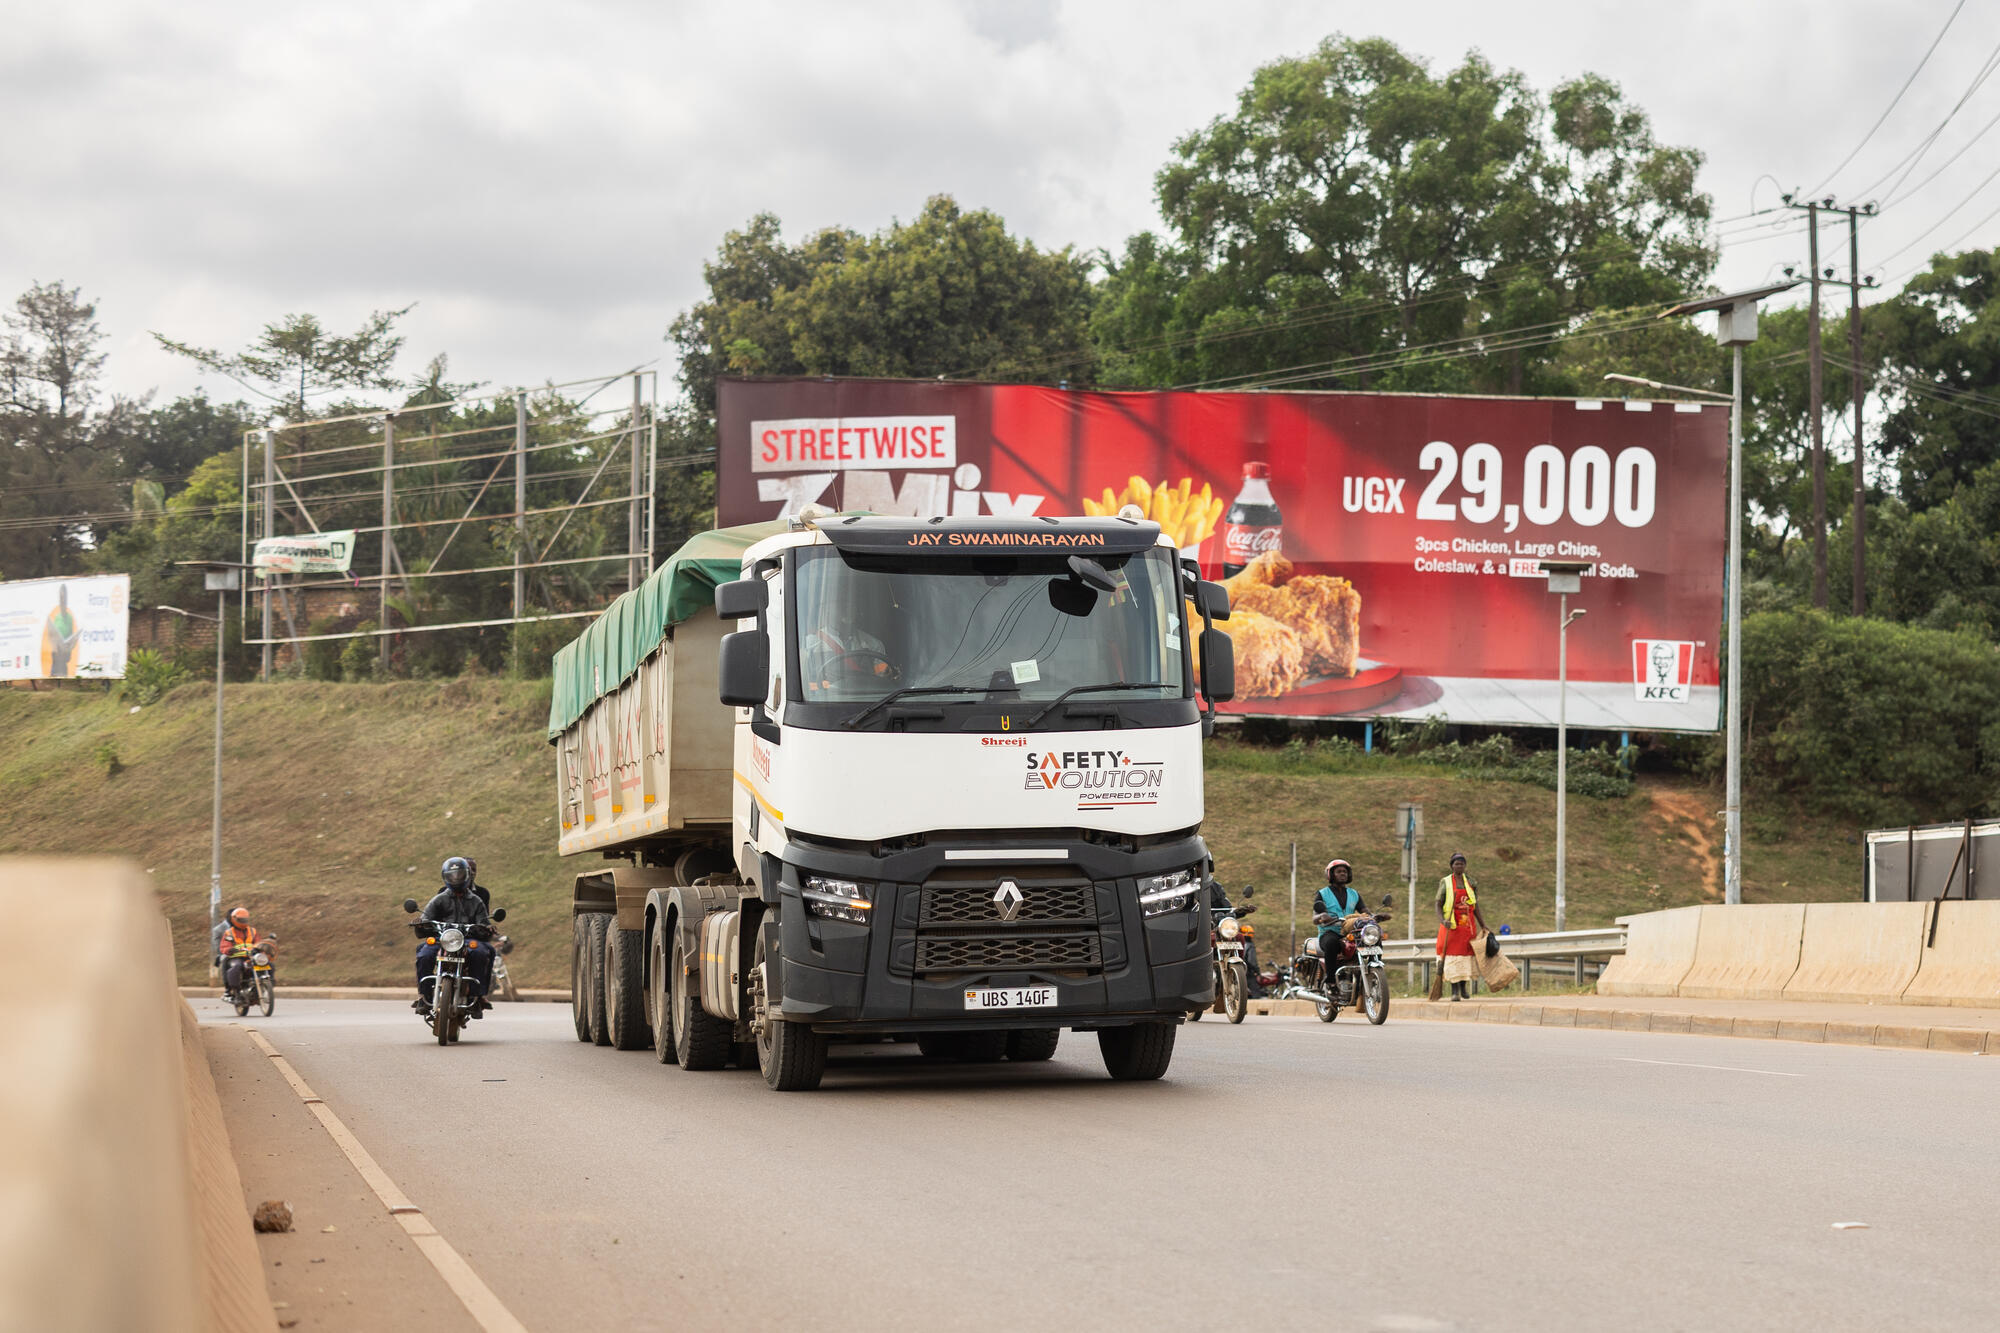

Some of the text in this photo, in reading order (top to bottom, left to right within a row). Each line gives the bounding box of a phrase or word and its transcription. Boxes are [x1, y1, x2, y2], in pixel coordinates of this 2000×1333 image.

[761, 426, 945, 463] STREETWISE
[1343, 441, 1656, 533] UGX 29,000
[908, 533, 1105, 547] JAY SWAMINARAYAN
[1415, 536, 1601, 558] 3pcs Chicken, Large Chips,
[1414, 557, 1479, 575] Coleslaw,
[1482, 561, 1495, 574] &
[1498, 563, 1507, 574] a
[1599, 563, 1639, 578] Soda.
[1644, 687, 1681, 699] KFC
[981, 737, 1028, 746] Shreeji
[1024, 769, 1163, 790] EVOLUTION
[1079, 792, 1133, 800] POWERED
[982, 989, 1050, 1007] UBS 140F
